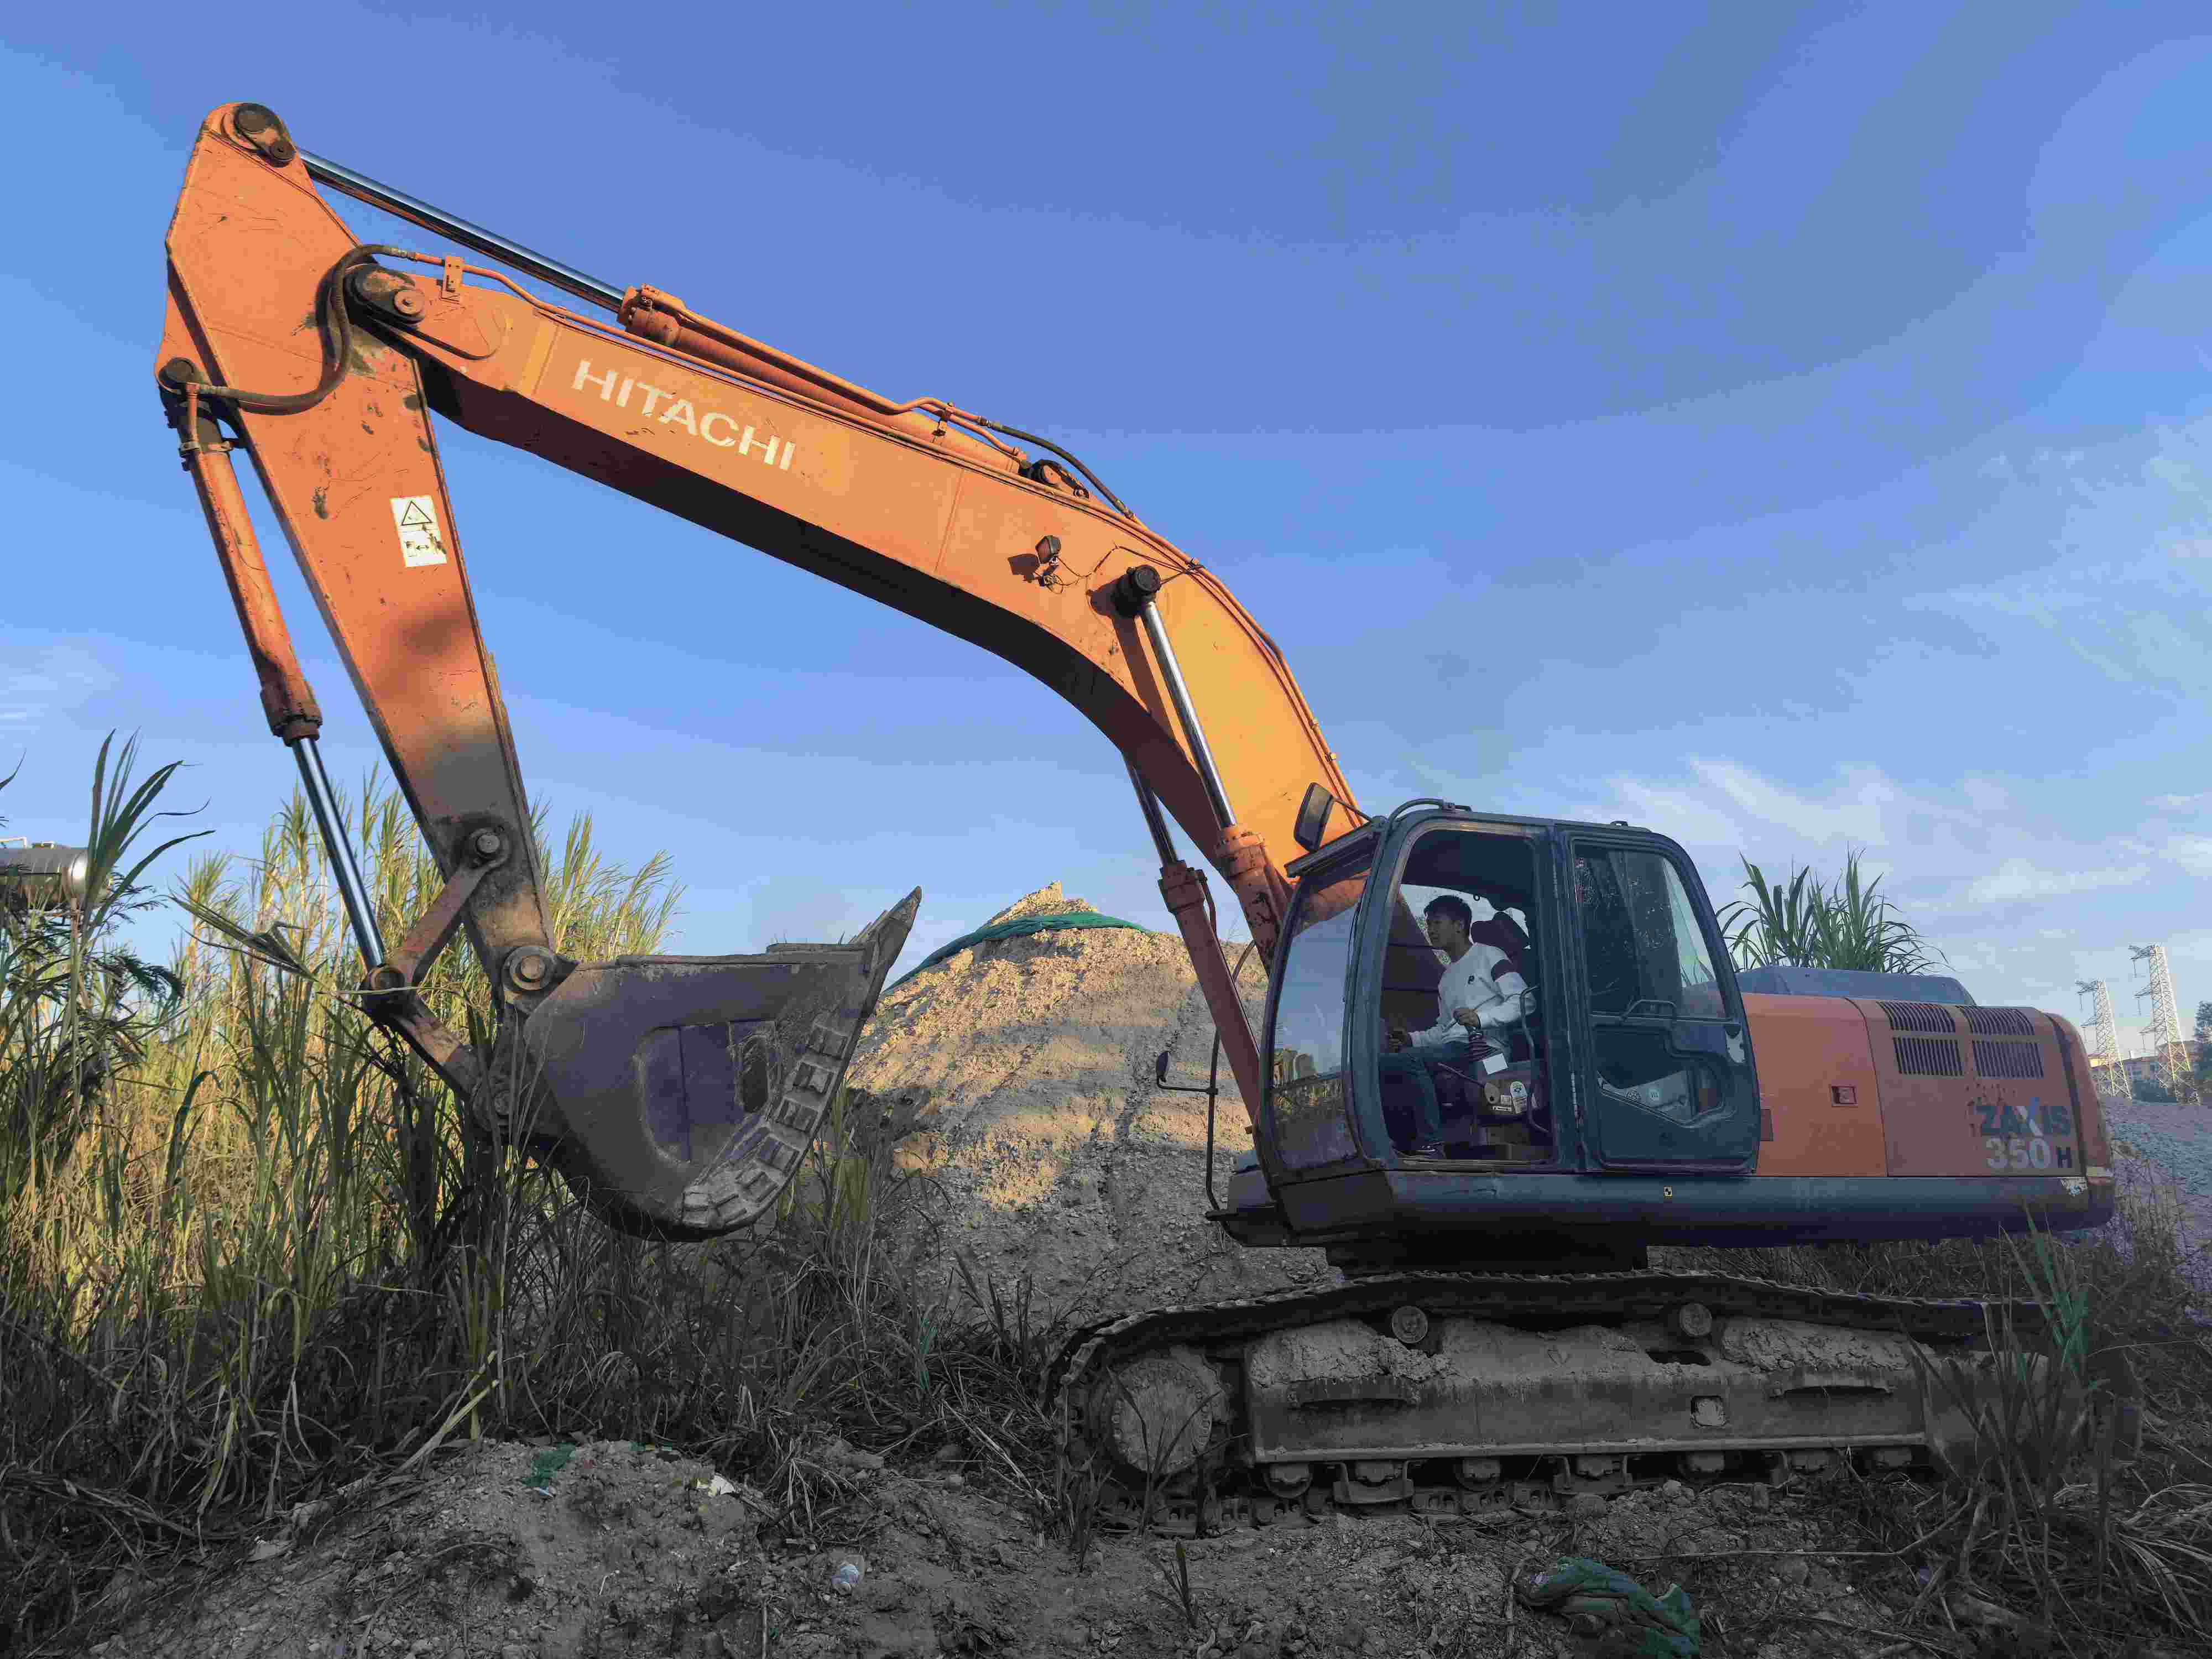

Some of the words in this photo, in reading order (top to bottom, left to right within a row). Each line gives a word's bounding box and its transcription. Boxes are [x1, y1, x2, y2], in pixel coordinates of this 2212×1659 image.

[572, 359, 795, 470] HITACHI
[1979, 1097, 2071, 1136] ZAXIS
[1986, 1137, 2051, 1168] 350
